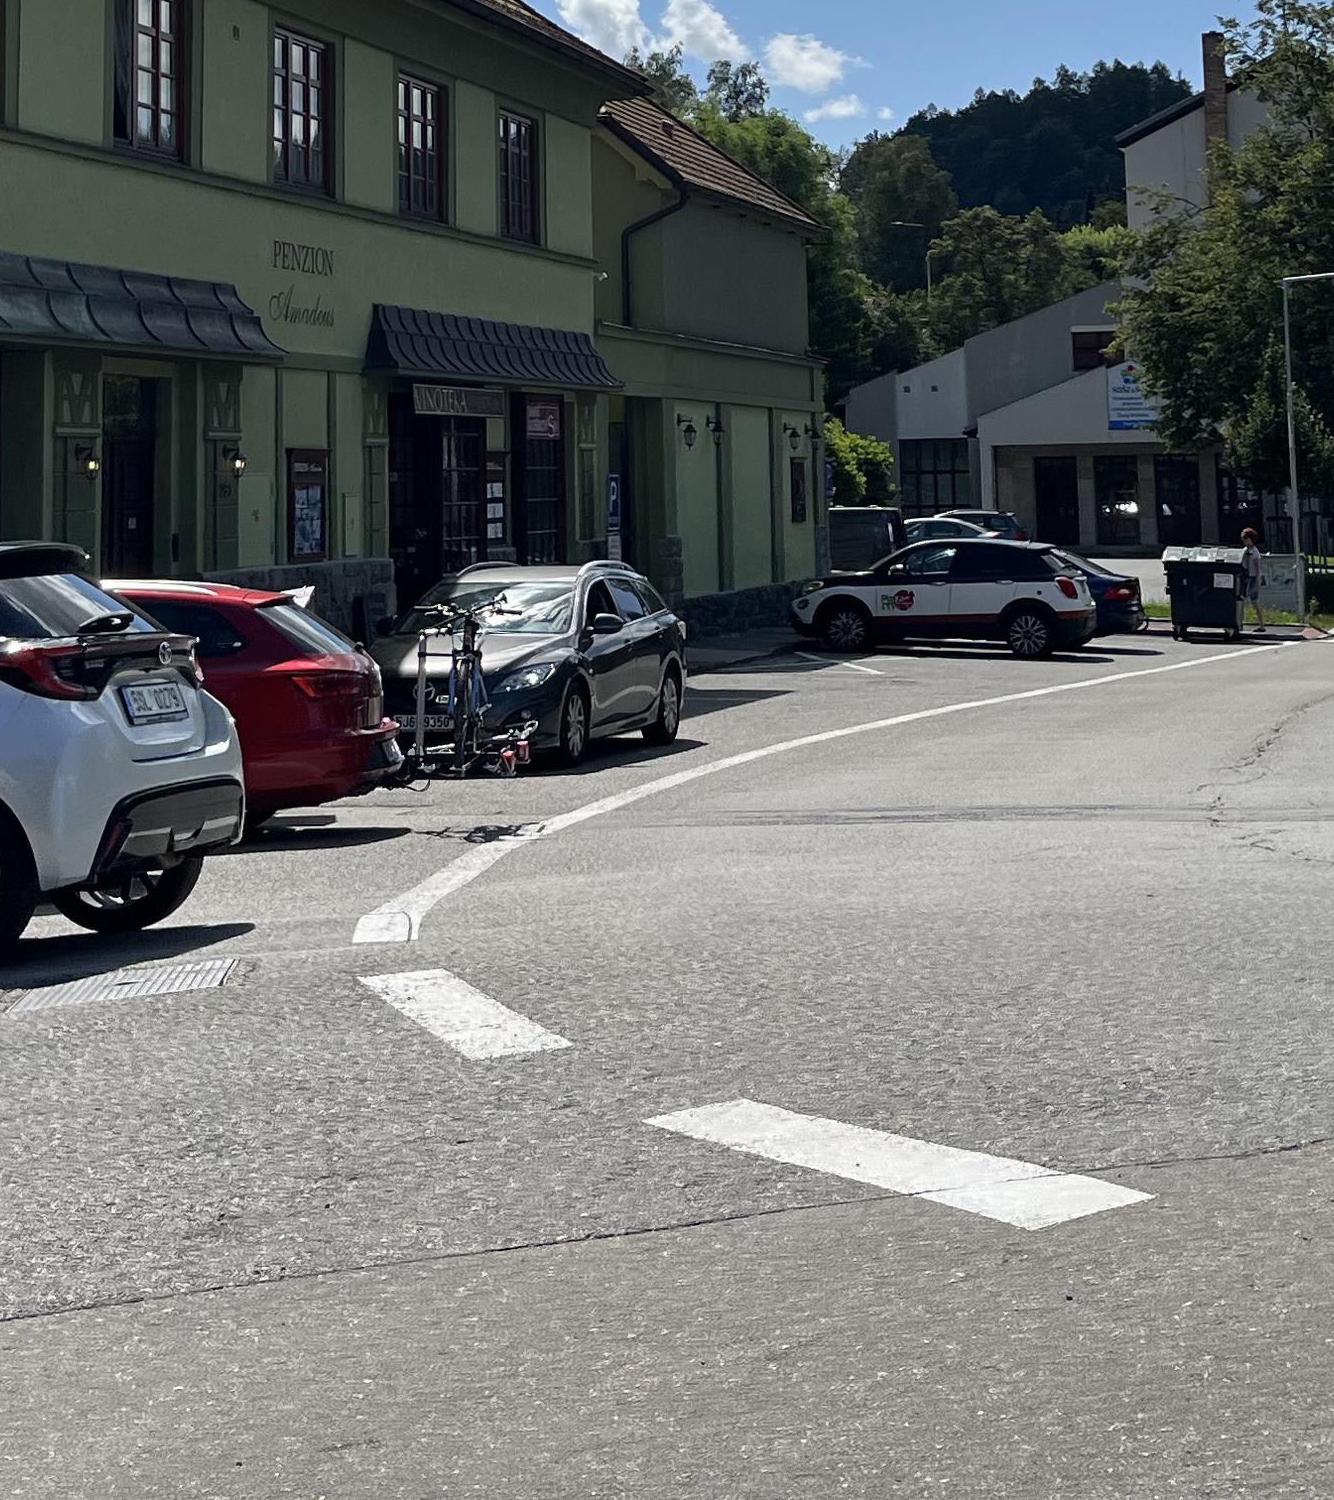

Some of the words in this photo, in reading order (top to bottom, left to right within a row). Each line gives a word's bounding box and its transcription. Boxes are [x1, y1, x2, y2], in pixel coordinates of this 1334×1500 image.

[272, 240, 334, 276] PENZION
[268, 284, 335, 327] Amadeus
[414, 388, 468, 413] VINOTEKA
[423, 716, 450, 728] 9350
